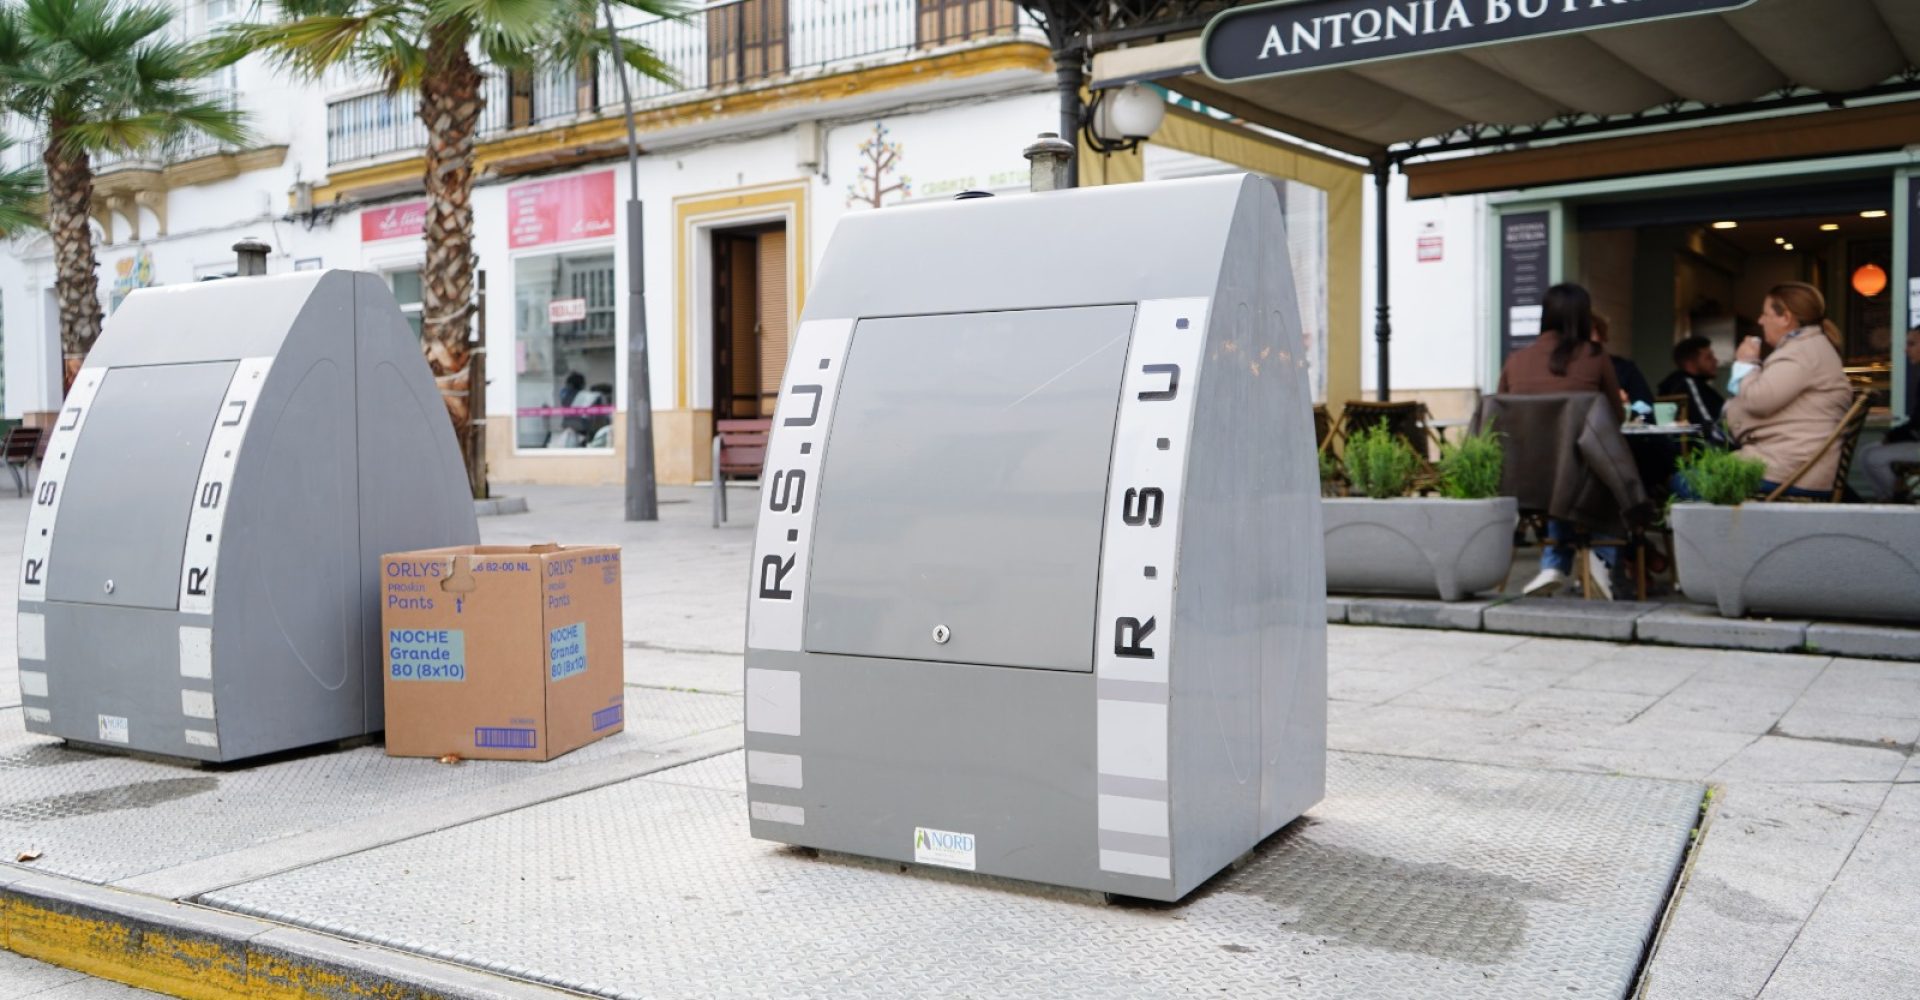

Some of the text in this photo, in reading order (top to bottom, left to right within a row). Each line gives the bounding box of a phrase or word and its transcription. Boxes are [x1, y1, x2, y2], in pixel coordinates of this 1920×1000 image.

[1257, 0, 1474, 59] ANTONIA
[517, 563, 530, 571] NL
[388, 595, 434, 609] Pants
[548, 594, 570, 609] Pants
[390, 631, 449, 643] NOCHE
[550, 625, 578, 643] NOCHE
[390, 647, 450, 660] Grande
[551, 643, 579, 660] Grande
[391, 664, 464, 680] 80 (8x10)
[932, 832, 973, 851] NORD
